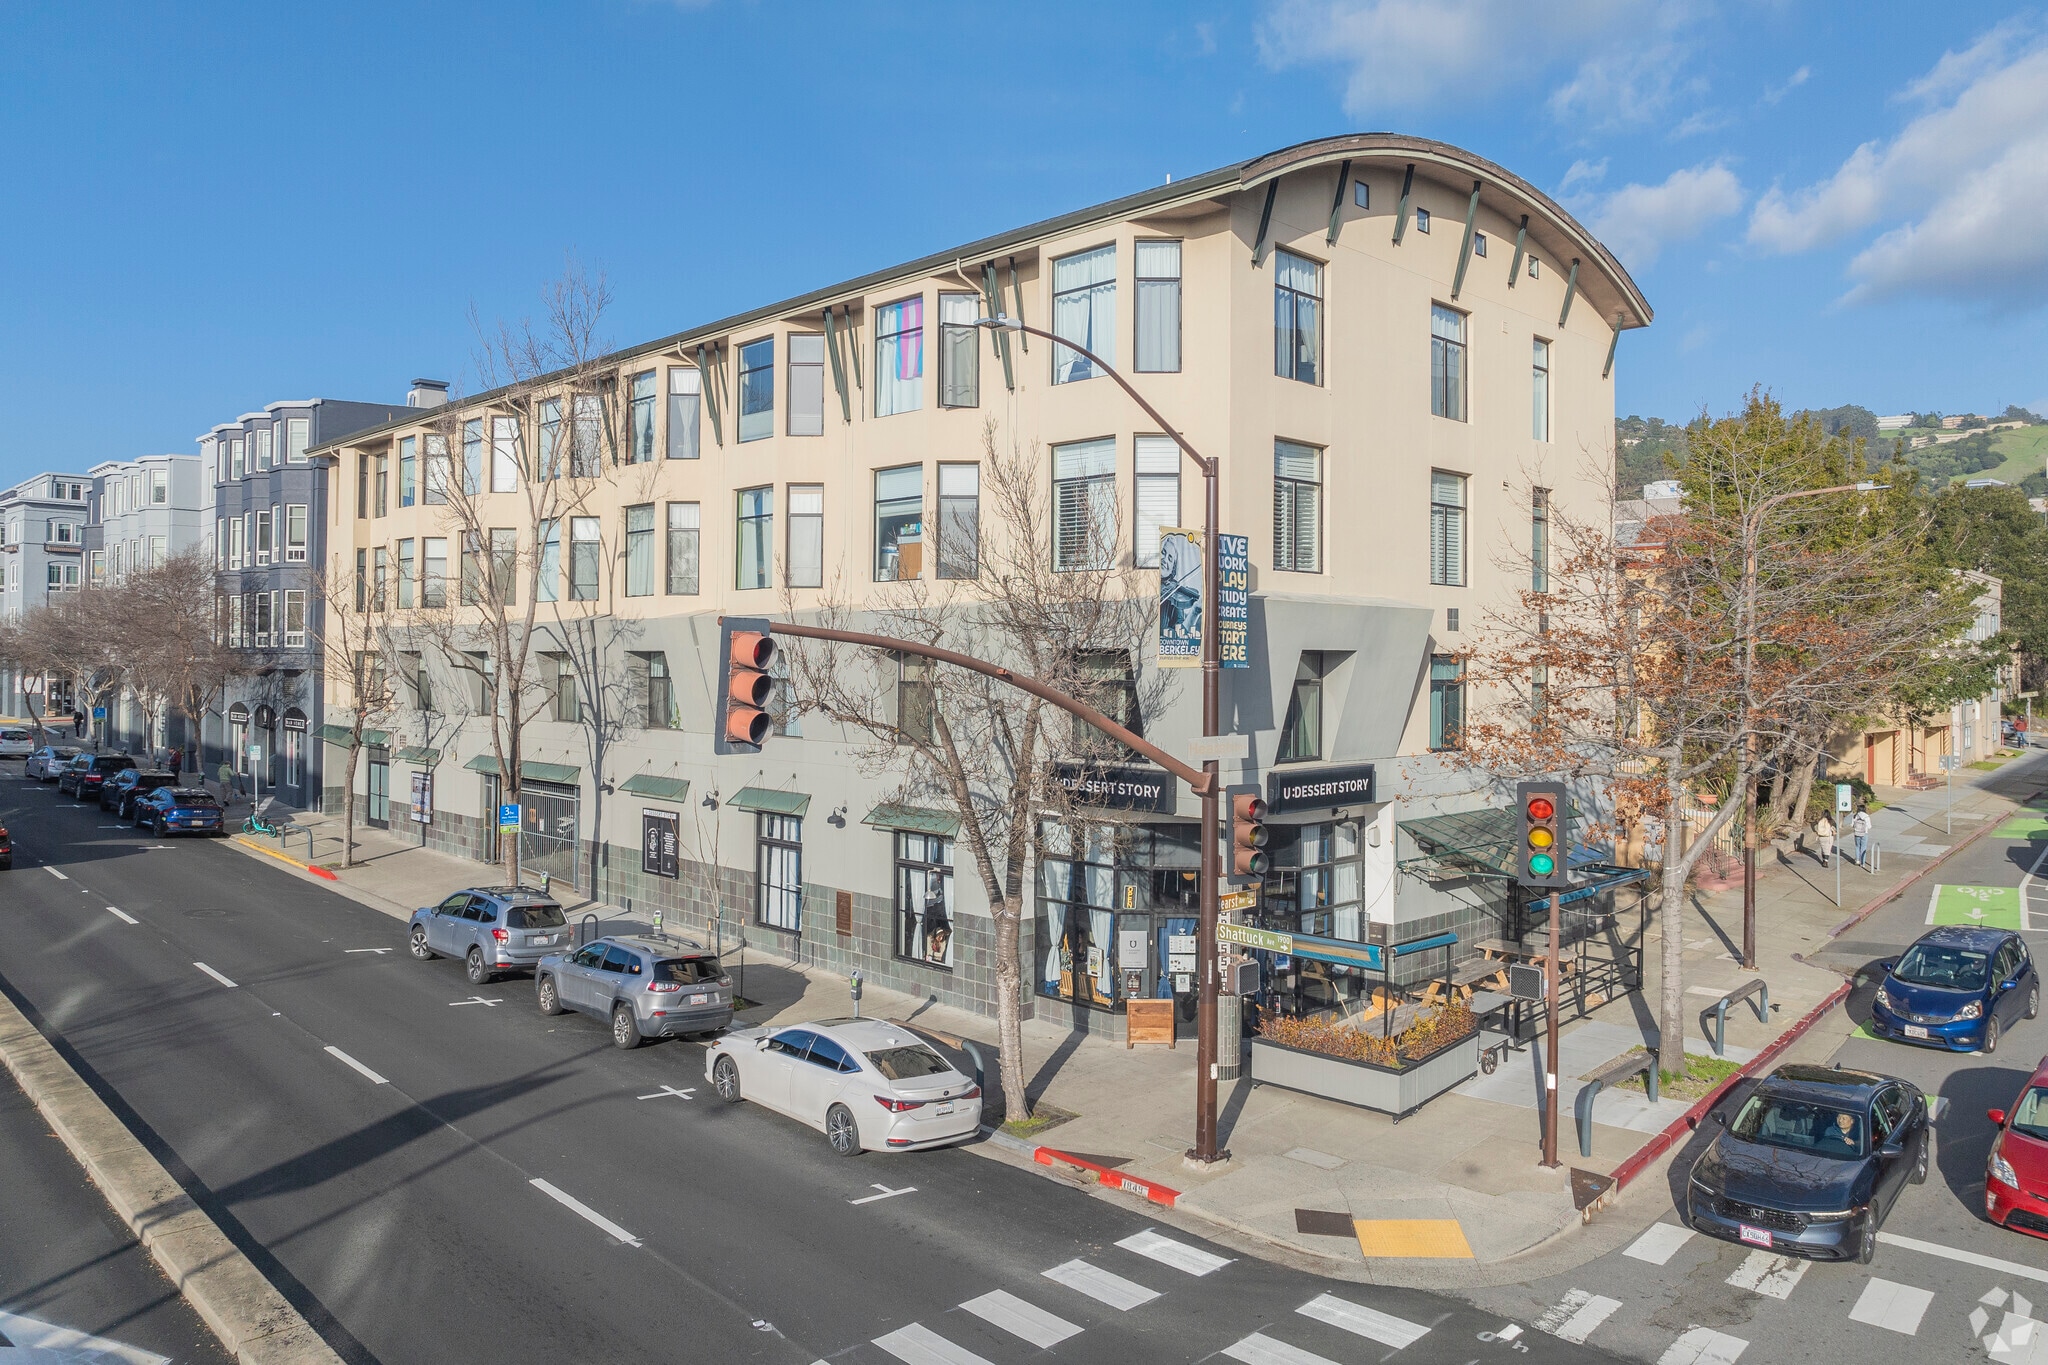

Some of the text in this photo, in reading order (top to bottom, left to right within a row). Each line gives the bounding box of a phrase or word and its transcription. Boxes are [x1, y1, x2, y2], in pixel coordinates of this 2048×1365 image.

[1218, 606, 1248, 619] REATE
[1218, 620, 1247, 631] OURNEYS
[1218, 630, 1247, 645] TART
[1159, 645, 1201, 656] BERKELEY
[504, 806, 510, 816] 3
[1219, 895, 1239, 910] earst
[1219, 925, 1264, 946] Shattuck
[1277, 935, 1290, 945] 1900
